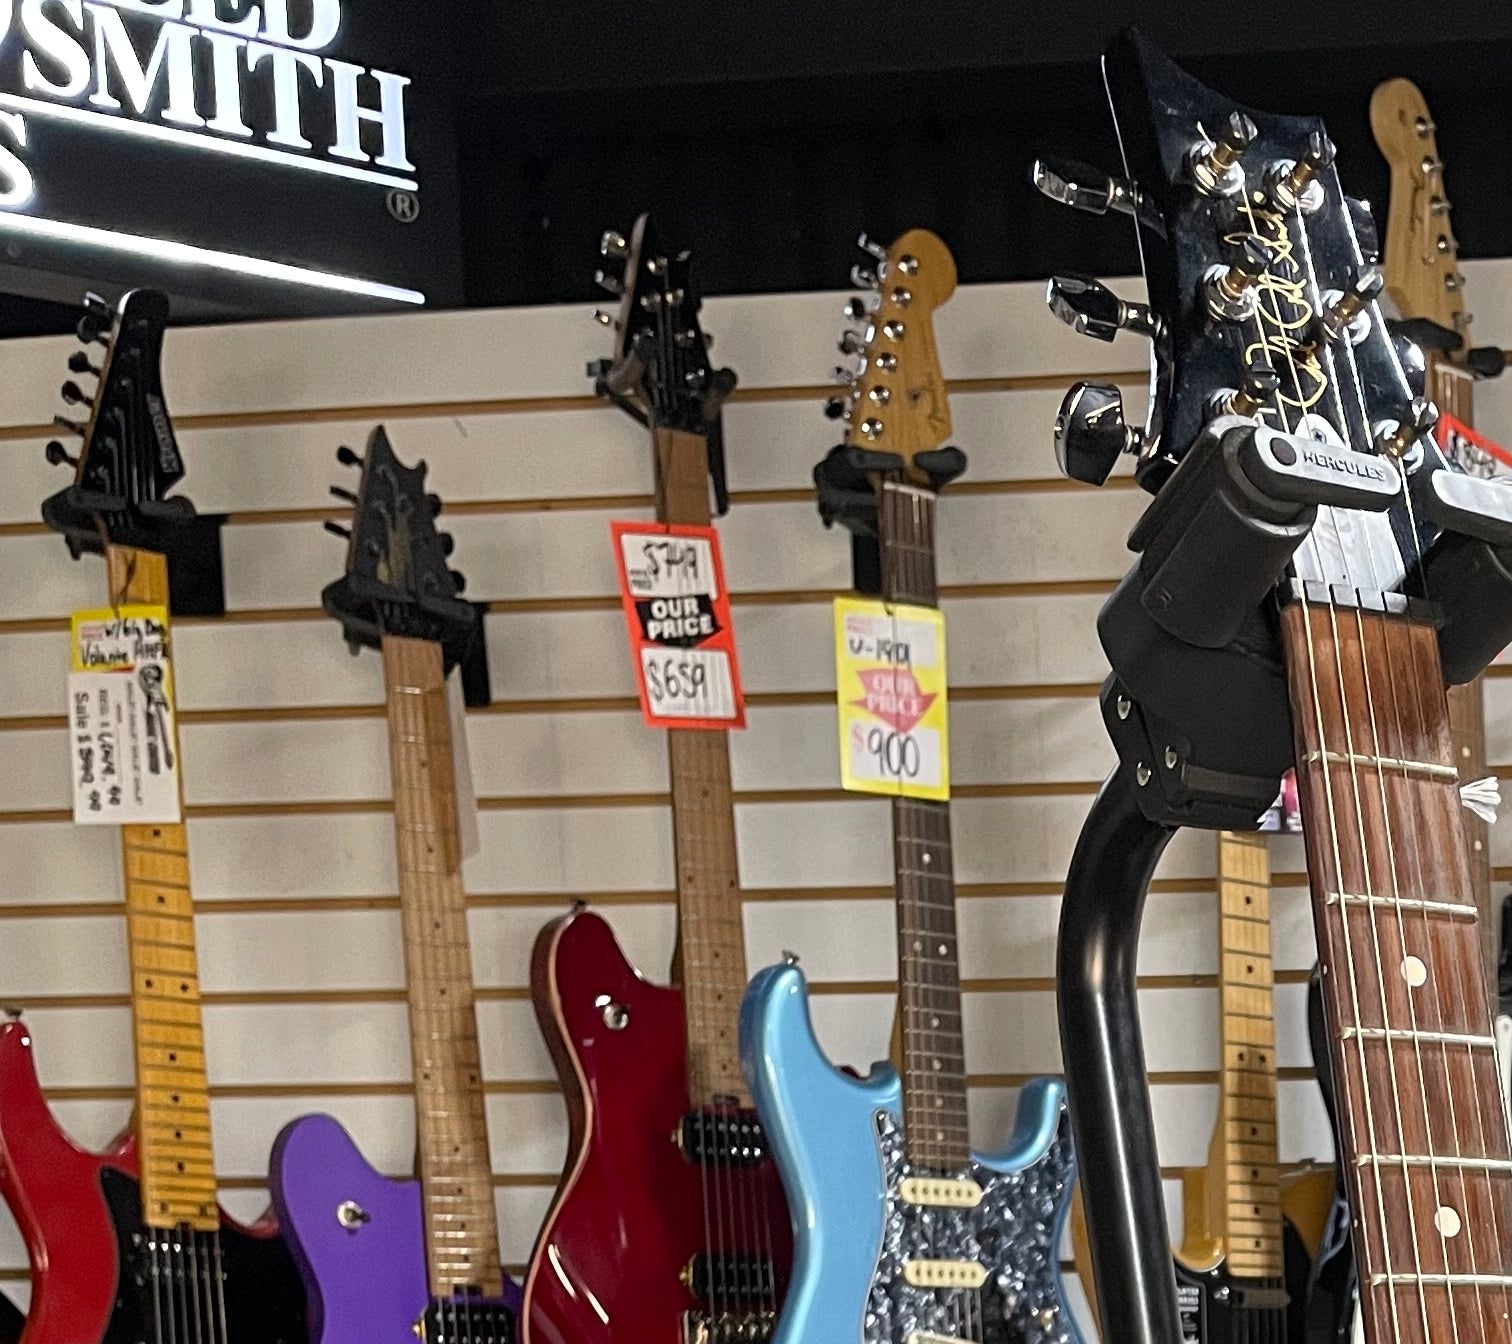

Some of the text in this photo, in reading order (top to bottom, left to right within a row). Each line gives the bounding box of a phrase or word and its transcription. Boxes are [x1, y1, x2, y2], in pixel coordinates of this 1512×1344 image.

[22, 0, 416, 172] SMITH
[1303, 451, 1388, 482] HERCULES
[651, 598, 700, 620] OUR
[647, 614, 715, 640] PRICE
[648, 659, 708, 702] $659
